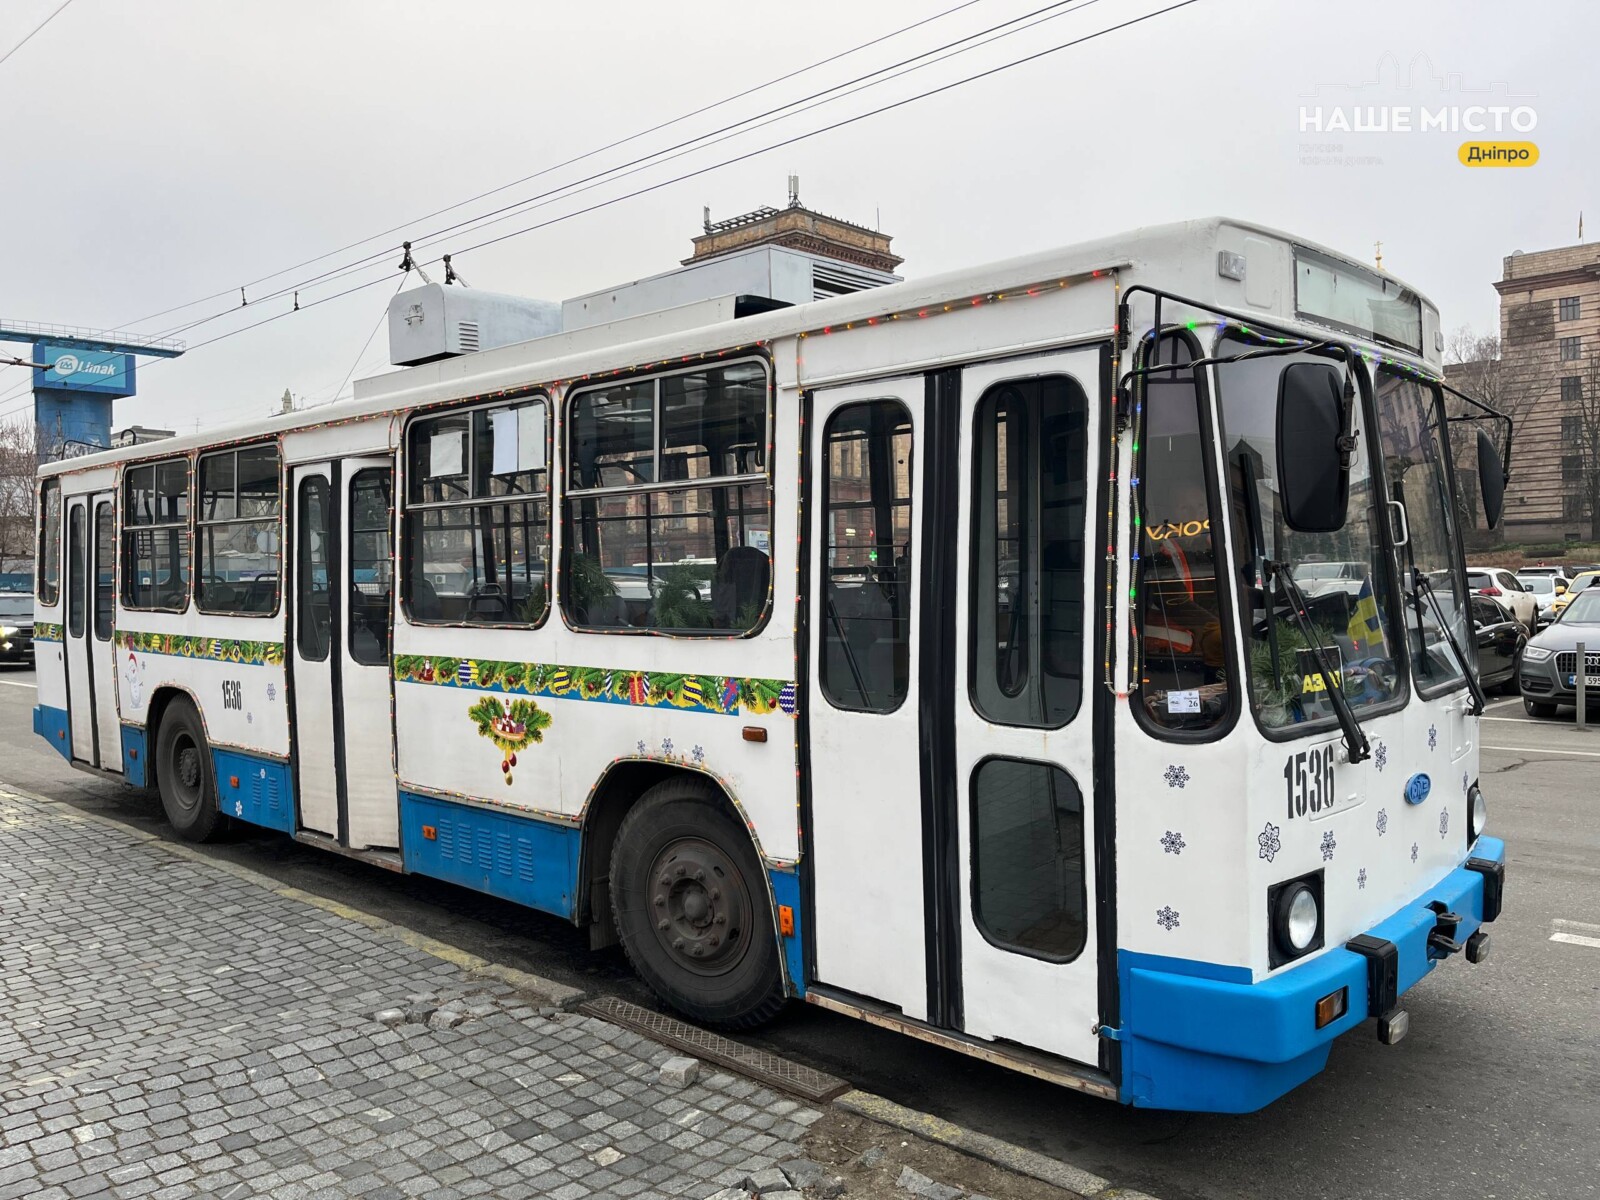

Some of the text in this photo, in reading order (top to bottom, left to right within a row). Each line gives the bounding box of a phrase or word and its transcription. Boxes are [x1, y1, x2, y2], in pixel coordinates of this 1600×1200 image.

[78, 361, 117, 375] Limak
[222, 680, 242, 711] 1536
[1188, 700, 1199, 708] 26
[1284, 744, 1335, 820] 1536
